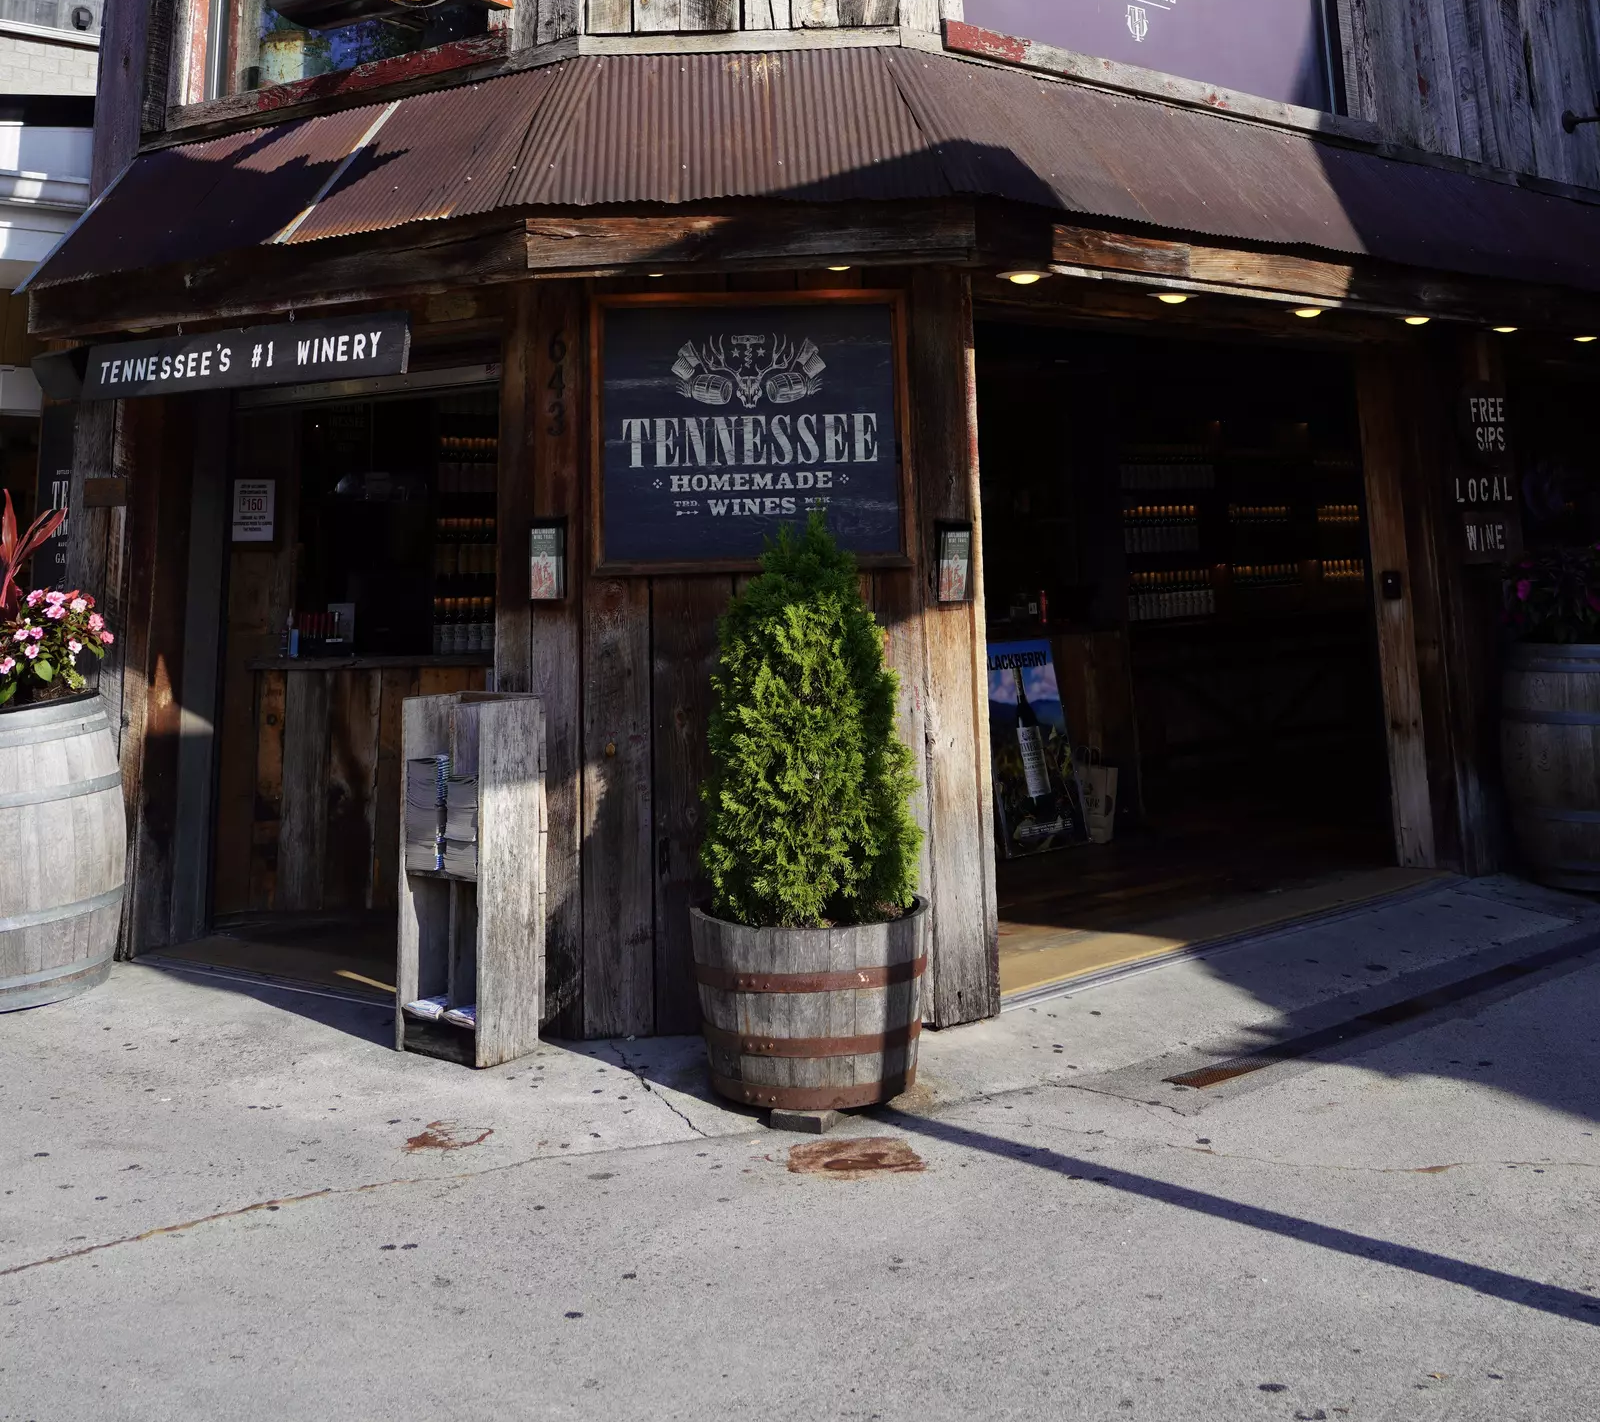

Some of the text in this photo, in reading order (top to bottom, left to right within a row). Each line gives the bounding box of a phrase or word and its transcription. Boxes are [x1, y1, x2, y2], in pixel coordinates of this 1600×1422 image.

[99, 330, 383, 385] TENNESSEE'S #1 WINERY
[1469, 397, 1505, 423] FREE
[622, 412, 879, 468] TENNESSEE
[1475, 426, 1507, 452] SIPS
[669, 471, 833, 493] HOMEMADE
[1455, 476, 1513, 503] LOCAL
[673, 500, 700, 508] TRD.
[707, 497, 797, 517] WINES
[1465, 523, 1505, 552] WINE
[987, 650, 1047, 671] LACKBERRY
